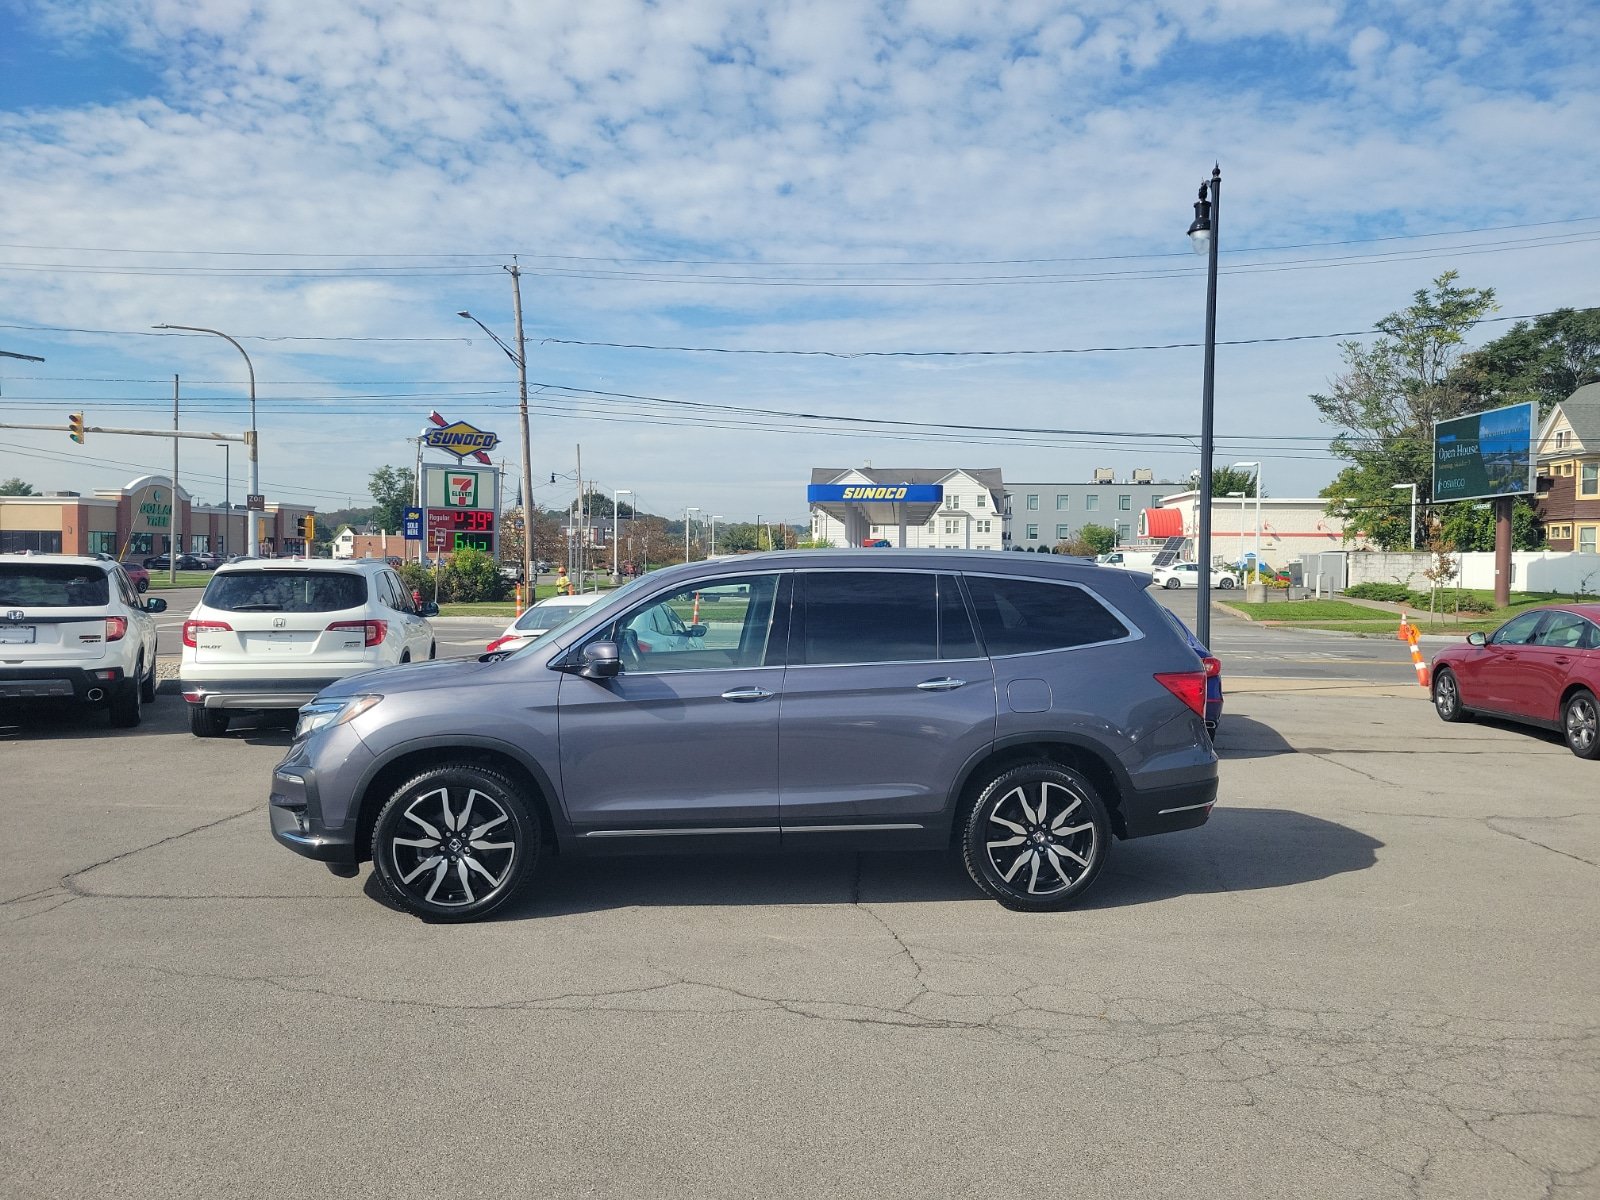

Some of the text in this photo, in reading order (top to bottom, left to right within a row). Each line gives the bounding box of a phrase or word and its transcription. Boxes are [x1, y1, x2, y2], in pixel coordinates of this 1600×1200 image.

[431, 431, 494, 447] SUNOCO
[1438, 444, 1478, 462] Open House
[842, 487, 908, 499] SUNOCO
[147, 516, 169, 527] TREE
[429, 513, 450, 522] Regular
